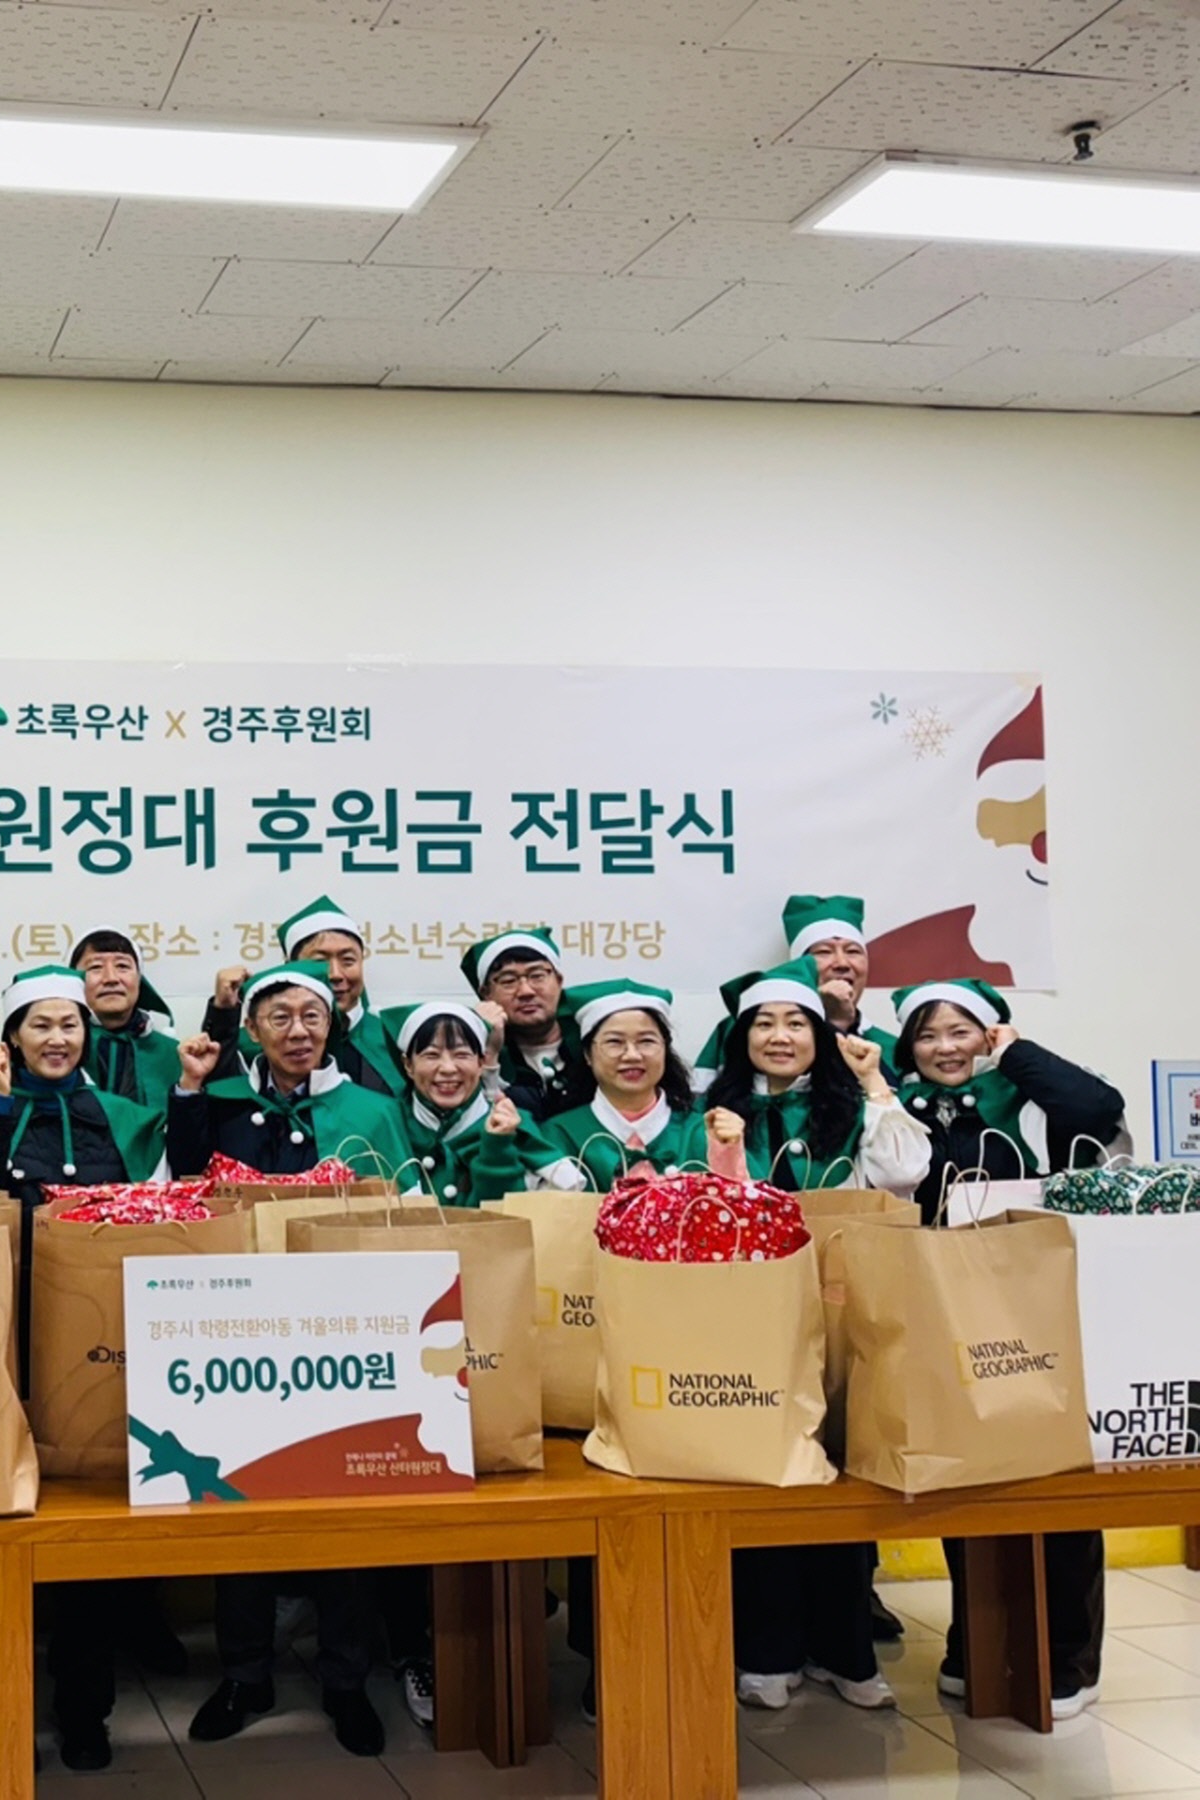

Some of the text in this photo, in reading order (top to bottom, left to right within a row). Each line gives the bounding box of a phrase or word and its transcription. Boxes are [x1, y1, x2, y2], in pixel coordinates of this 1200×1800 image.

[15, 703, 149, 741] 초록우산
[202, 705, 372, 744] 경주후원회
[246, 788, 483, 874] 후원금
[509, 788, 735, 875] 전달식
[128, 922, 200, 962] 장소
[561, 919, 667, 960] 대강당
[147, 1314, 410, 1341] 경주시 학령전환아동 겨울의류 지원금
[967, 1338, 1029, 1361] NATIONAL
[167, 1351, 397, 1404] 6,000,000원
[972, 1352, 1056, 1380] GEOGRAPHIC
[669, 1373, 757, 1389] NATIONAL
[1130, 1381, 1185, 1407] THE
[668, 1389, 781, 1407] GEOGRAPHIC
[1087, 1407, 1185, 1434] NORTH
[1112, 1433, 1184, 1459] FACE
[345, 1460, 443, 1477] 초록우산 산타원정대
